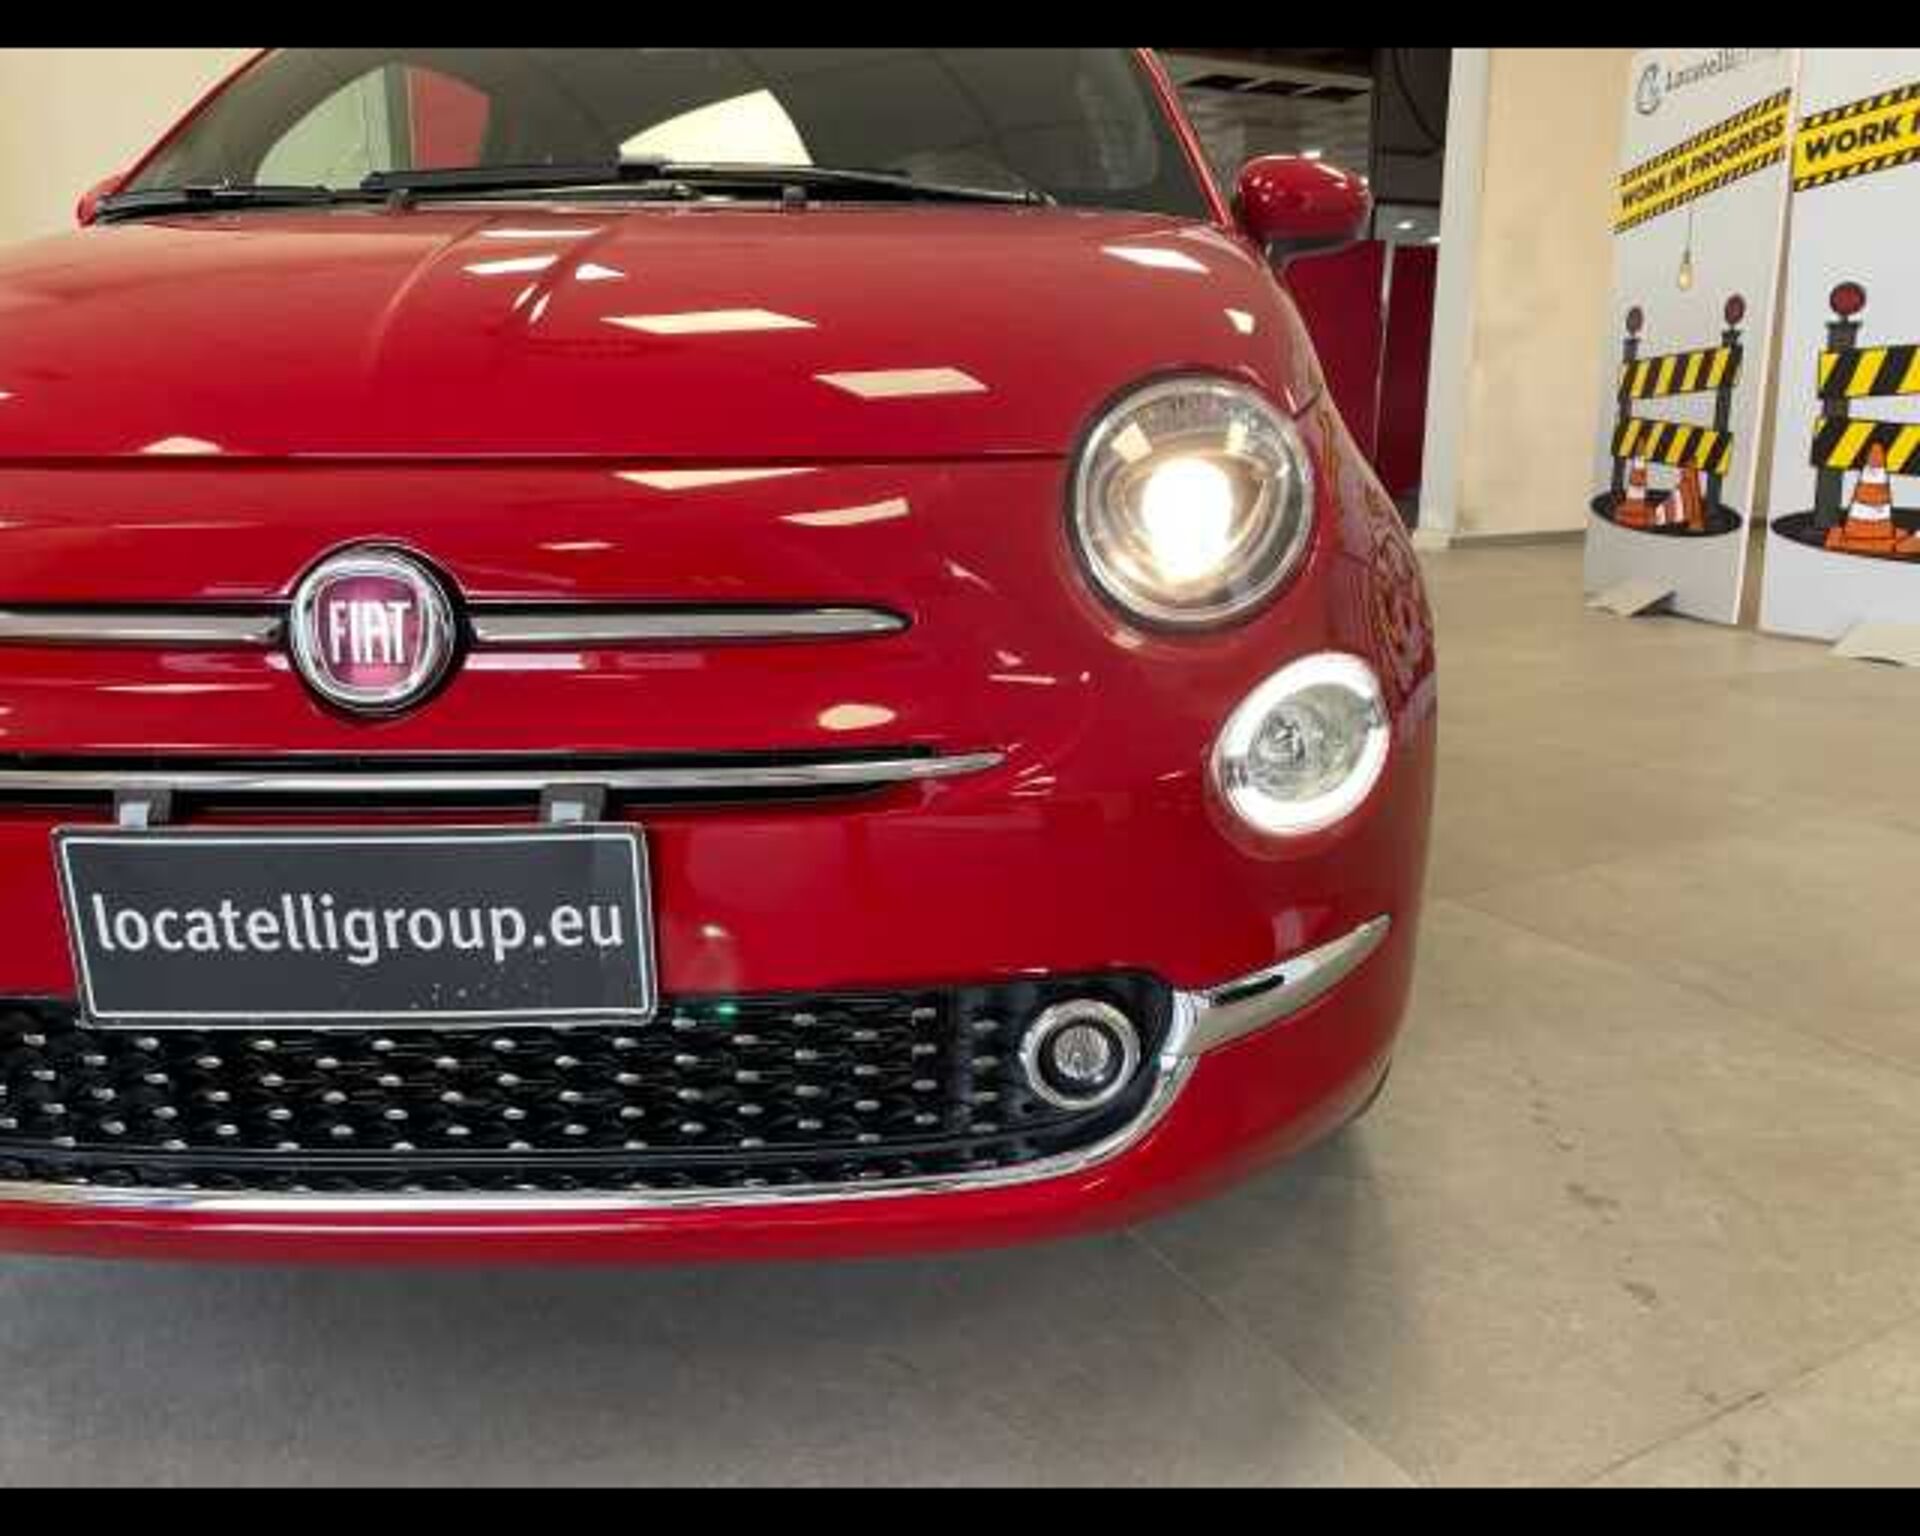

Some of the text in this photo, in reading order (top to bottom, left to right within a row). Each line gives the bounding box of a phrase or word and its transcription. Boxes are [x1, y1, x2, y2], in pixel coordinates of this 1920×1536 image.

[1670, 160, 1687, 182] IN
[1691, 115, 1784, 168] PROGRESS
[1805, 115, 1901, 163] WORK
[329, 600, 412, 664] FIAT
[93, 893, 624, 964] locatelligroup.eu
